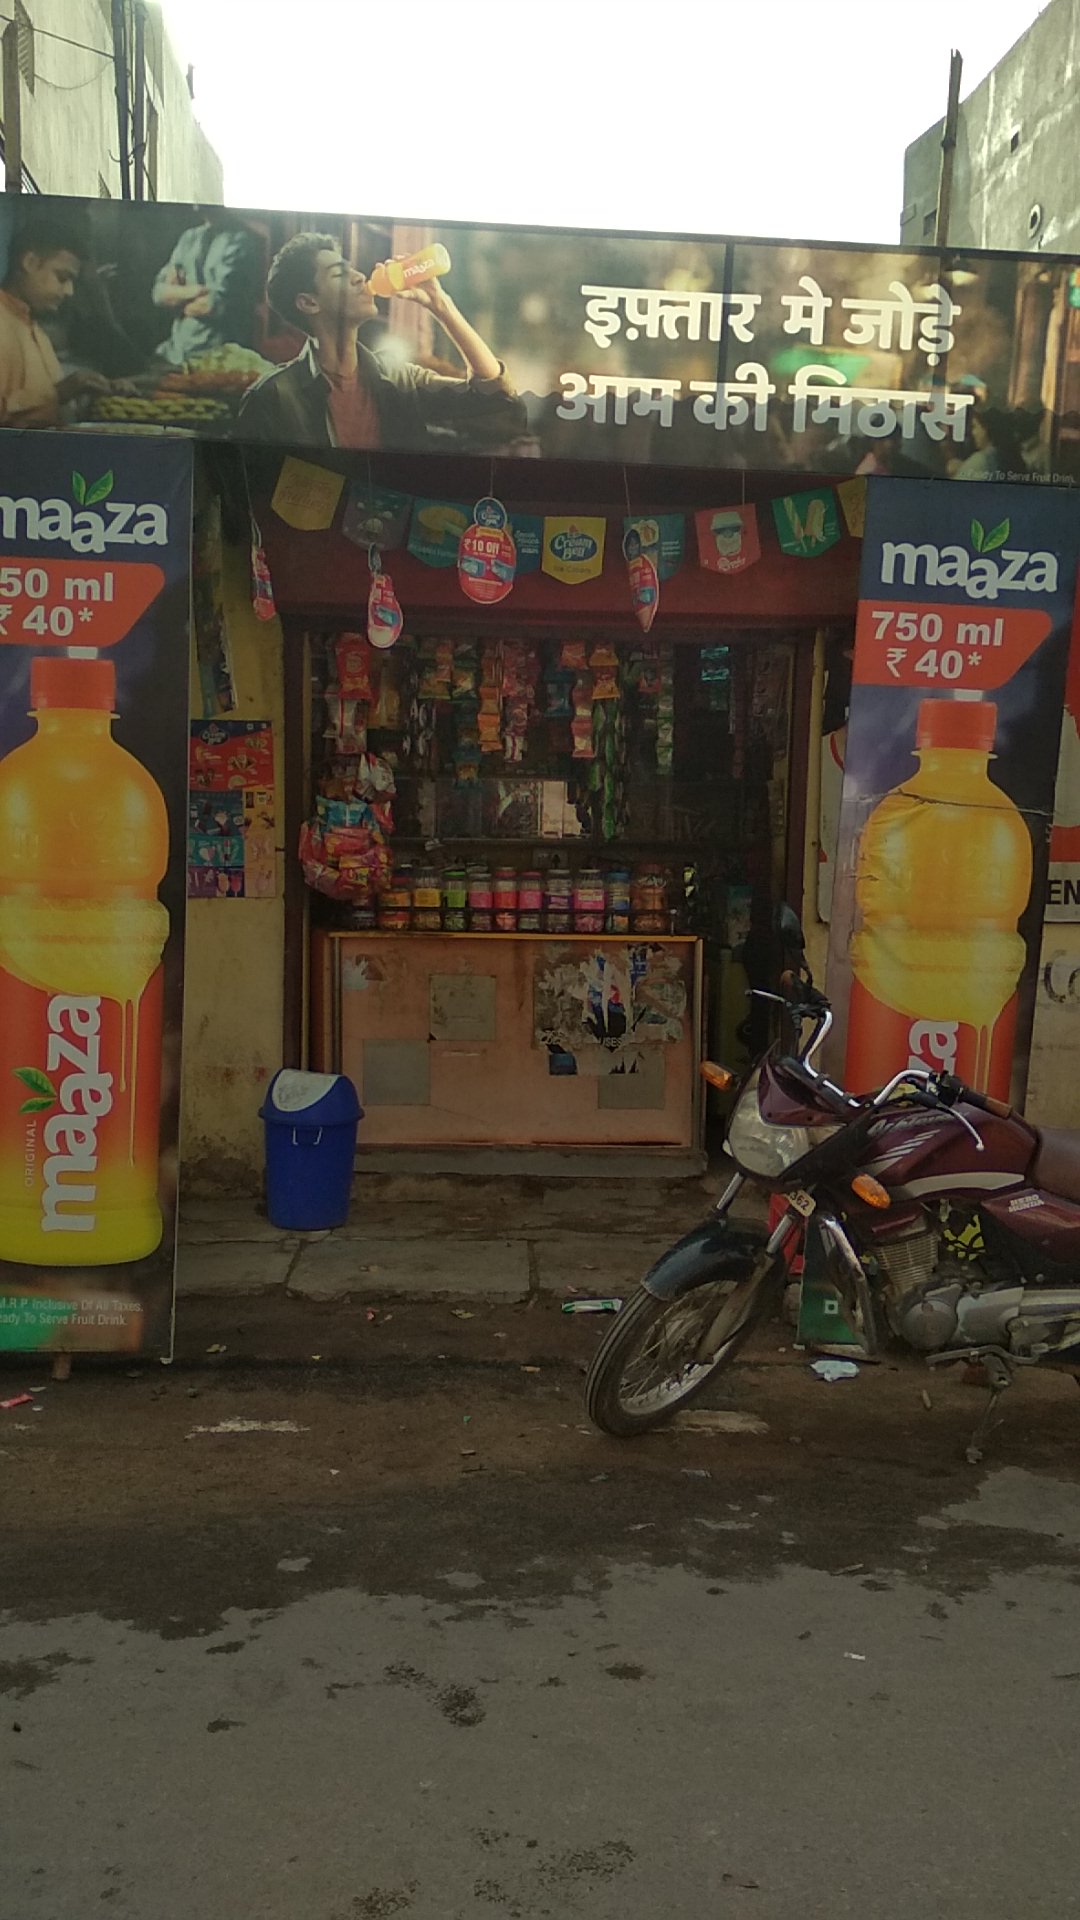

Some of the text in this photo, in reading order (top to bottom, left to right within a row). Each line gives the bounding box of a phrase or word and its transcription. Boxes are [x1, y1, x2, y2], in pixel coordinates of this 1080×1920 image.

[402, 259, 436, 278] maaza
[581, 276, 961, 366] इफ़्तार मे जोड़े
[555, 362, 975, 442] आम की मिठास
[1007, 470, 1030, 481] Serve
[1032, 472, 1050, 482] Fruit
[0, 496, 168, 553] maaza
[554, 536, 592, 550] Cream
[0, 568, 113, 601] 50 ml
[880, 542, 1058, 600] maaza
[871, 611, 1004, 646] 750 ml
[40, 995, 114, 1232] maaza
[24, 1119, 37, 1188] ORIGINAL
[1008, 1199, 1045, 1213] HONDA
[1010, 1194, 1039, 1206] HERO
[24, 1312, 36, 1324] To
[39, 1313, 69, 1325] Serve
[71, 1313, 94, 1325] Fruit
[32, 1298, 78, 1311] Inclusive
[81, 1299, 94, 1310] Of
[96, 1300, 108, 1311] All
